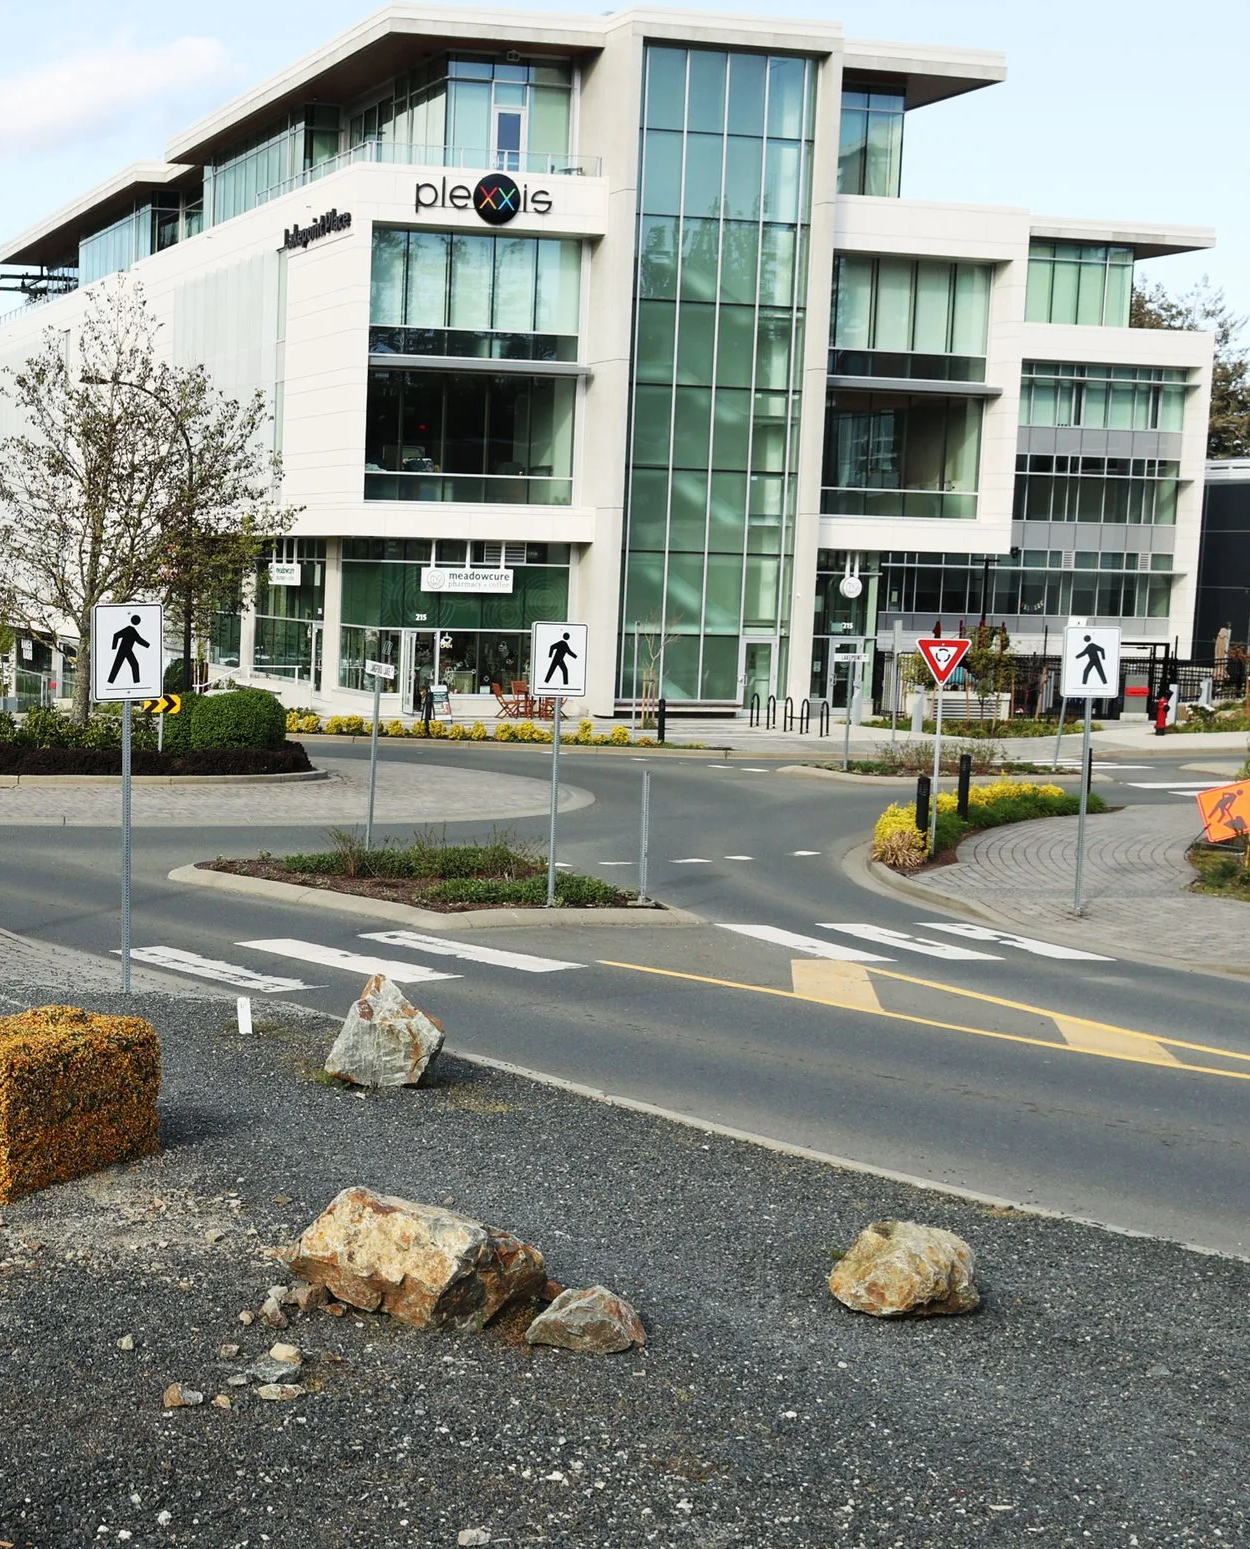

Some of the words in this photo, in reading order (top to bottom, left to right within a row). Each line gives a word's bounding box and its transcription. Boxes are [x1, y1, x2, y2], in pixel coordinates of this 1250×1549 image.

[415, 176, 552, 213] plexxis
[449, 571, 510, 581] meadowcure
[448, 580, 482, 589] pharmacy
[415, 613, 427, 621] 215
